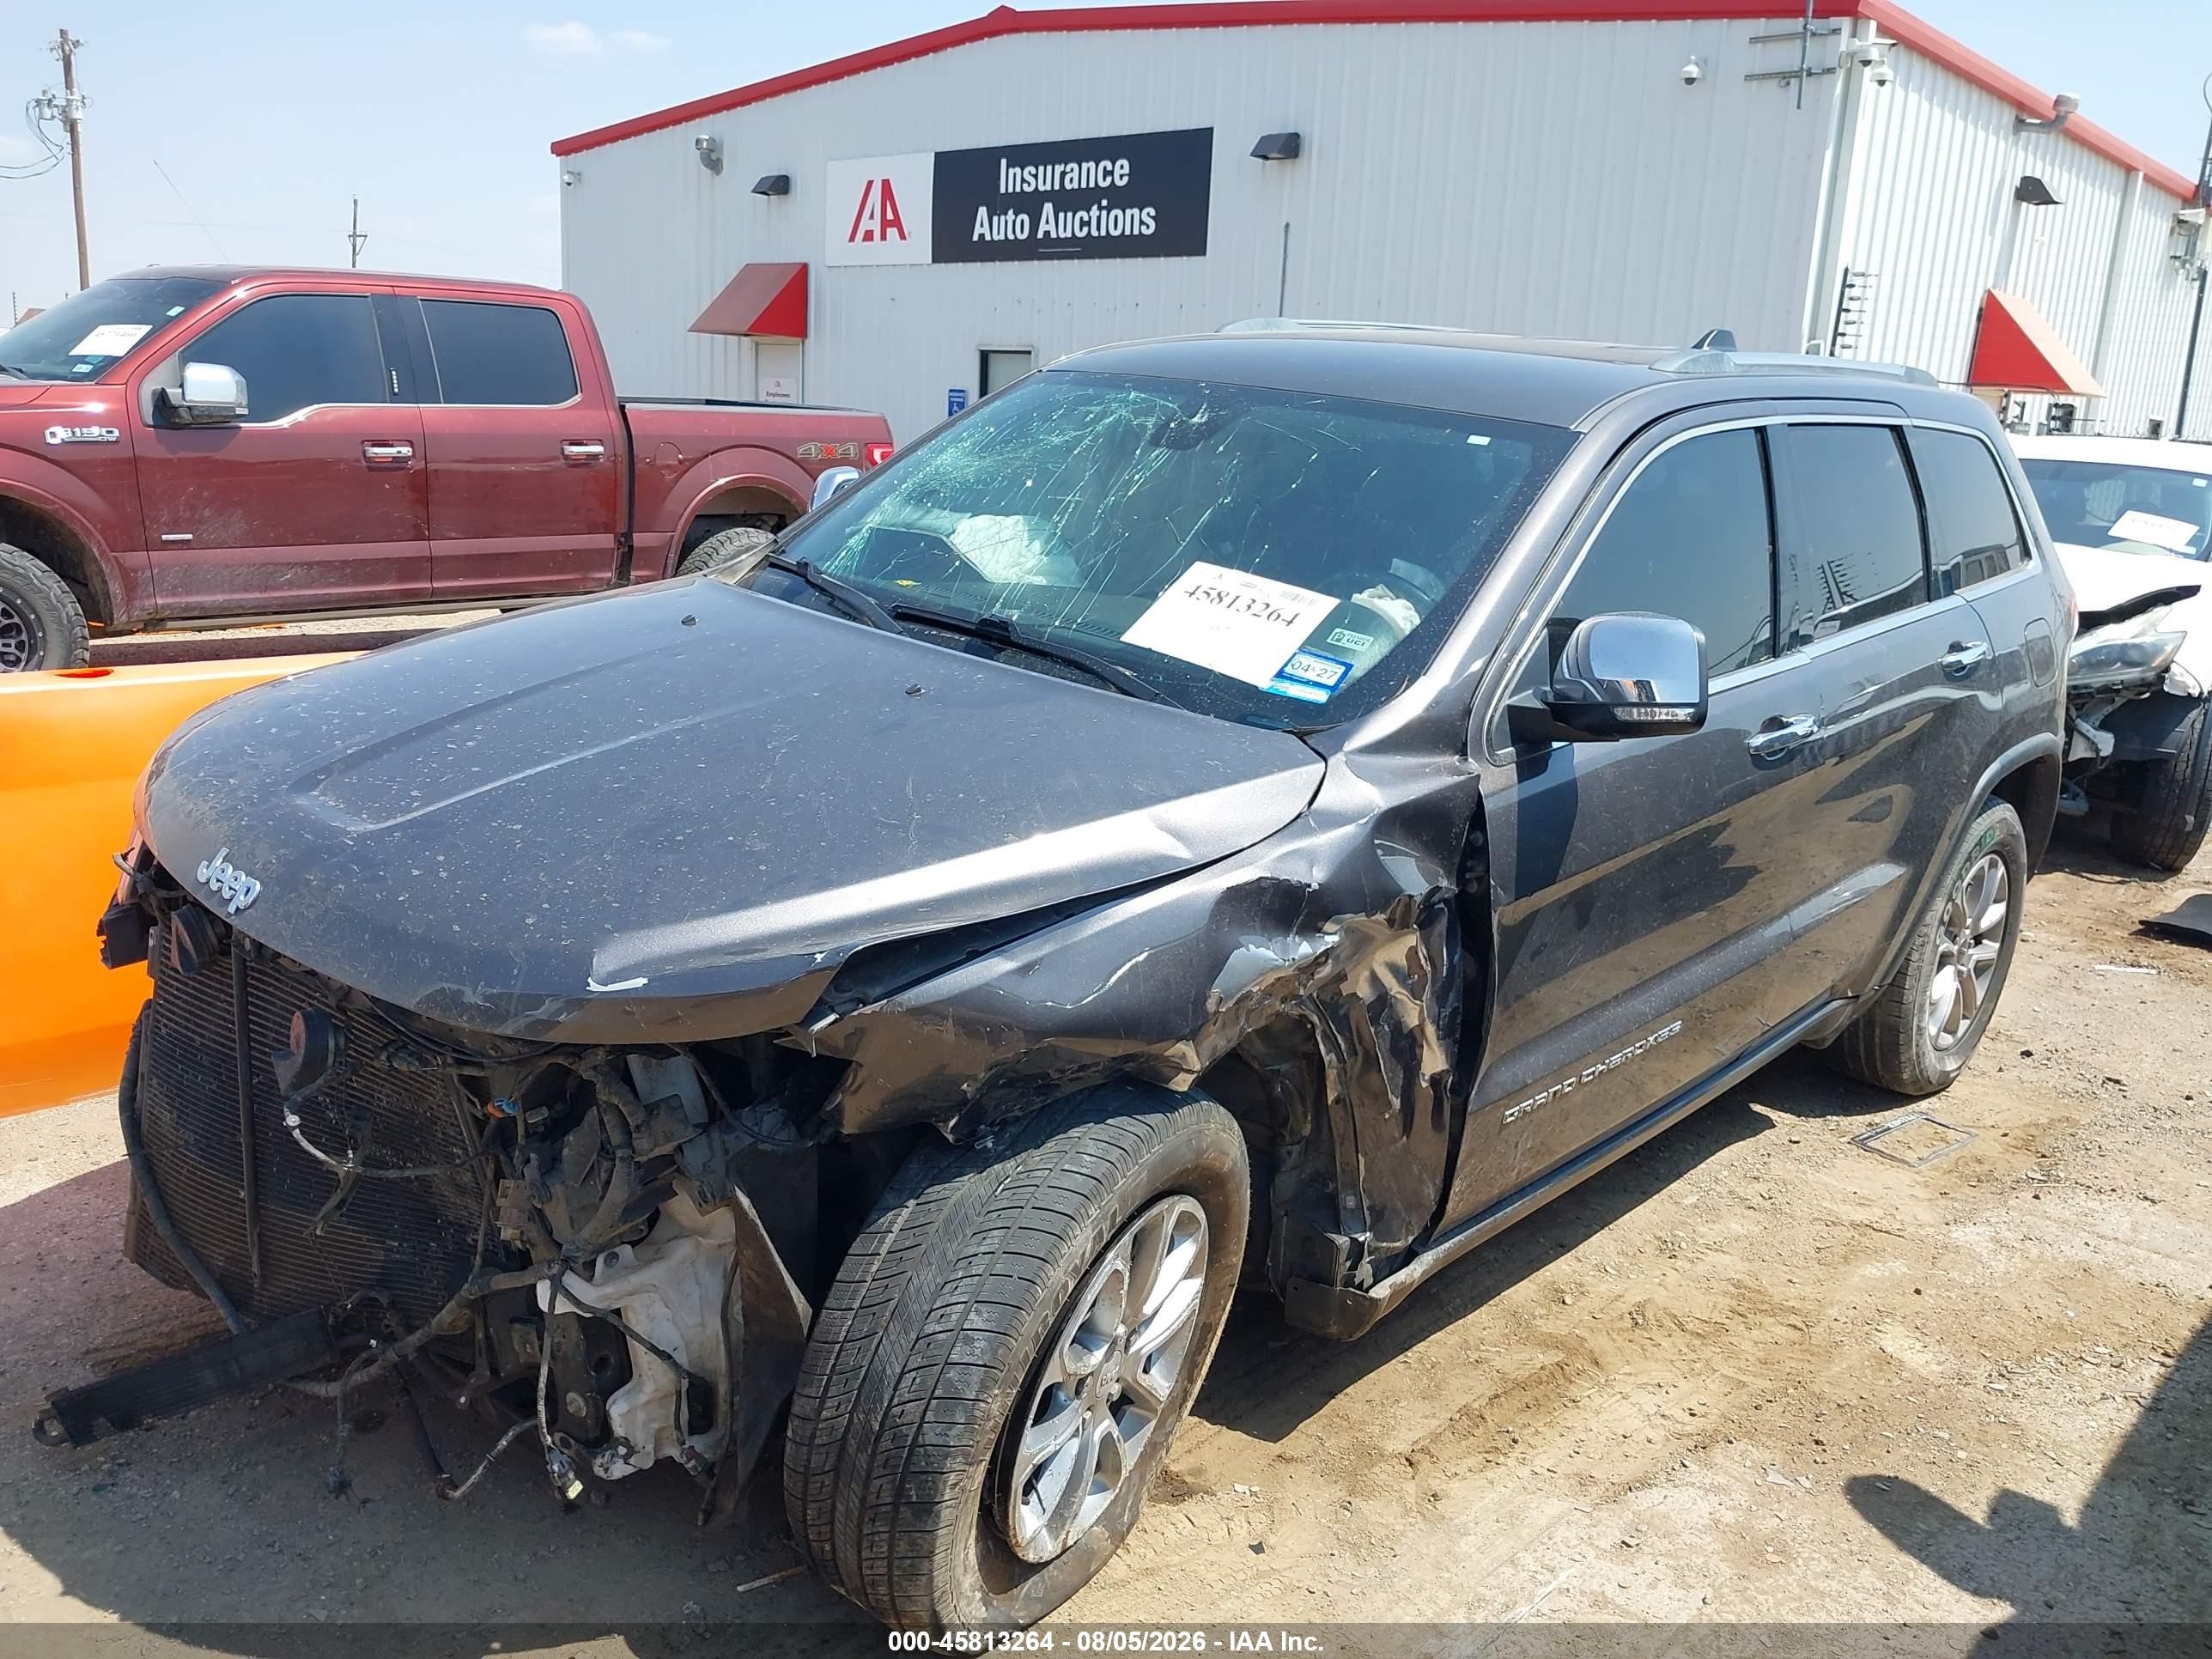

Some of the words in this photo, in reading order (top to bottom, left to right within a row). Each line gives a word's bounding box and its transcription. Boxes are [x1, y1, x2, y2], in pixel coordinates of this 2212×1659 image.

[999, 157, 1131, 194] Insurance
[971, 205, 1030, 242] Auto
[1036, 198, 1157, 240] Auctions
[1184, 584, 1301, 627] 45813264
[1346, 637, 1366, 647] UCI
[197, 847, 261, 915] Jeep
[1503, 1076, 1577, 1124] GRAND
[1581, 1020, 1682, 1084] CHEROKEE
